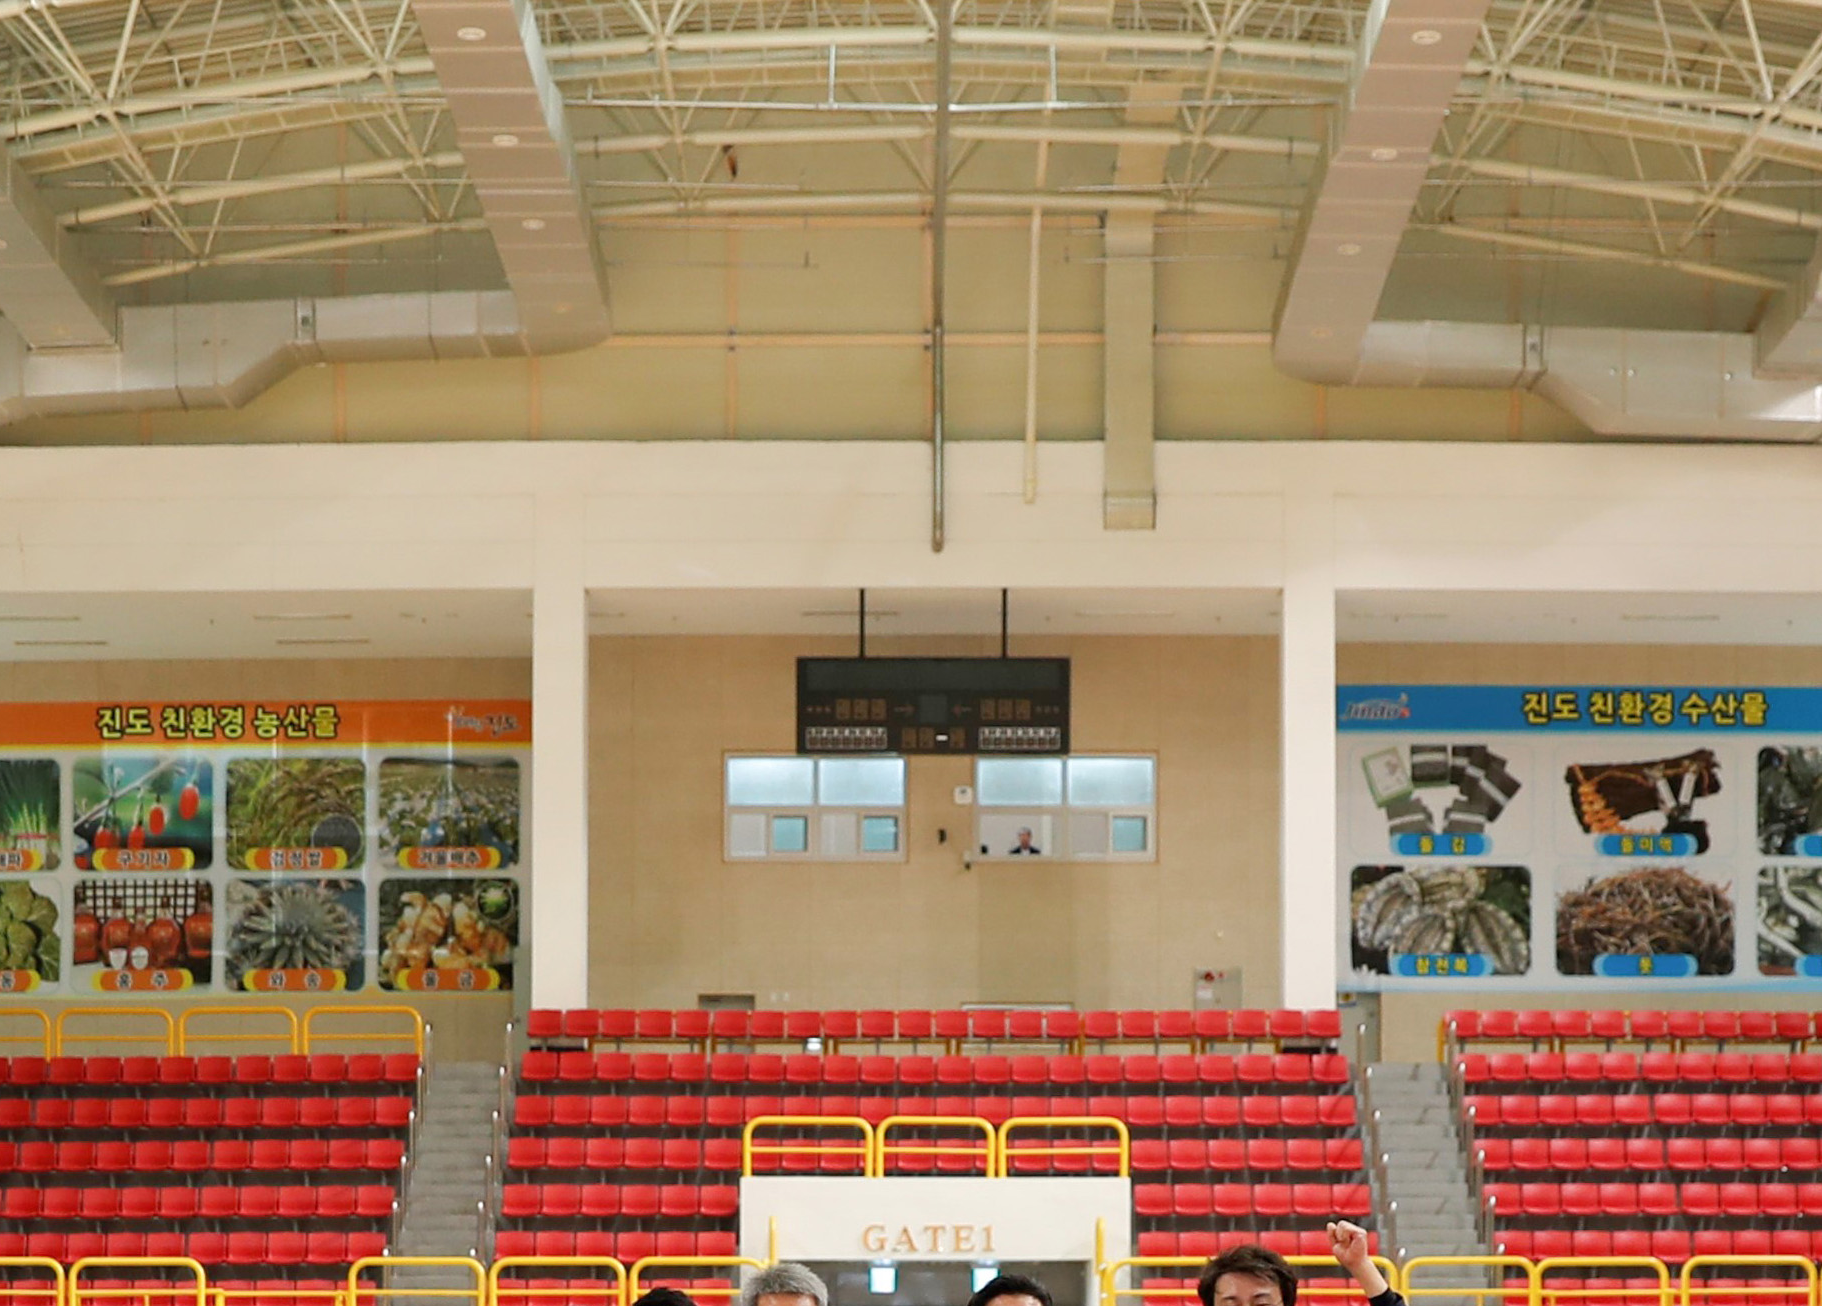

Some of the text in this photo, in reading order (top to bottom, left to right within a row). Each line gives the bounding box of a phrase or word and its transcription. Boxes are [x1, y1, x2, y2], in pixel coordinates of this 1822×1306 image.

[97, 705, 339, 739] 진도 친환경 농산물
[1522, 692, 1769, 726] 진도 친환경 수산물
[419, 849, 481, 869] 겨울배추
